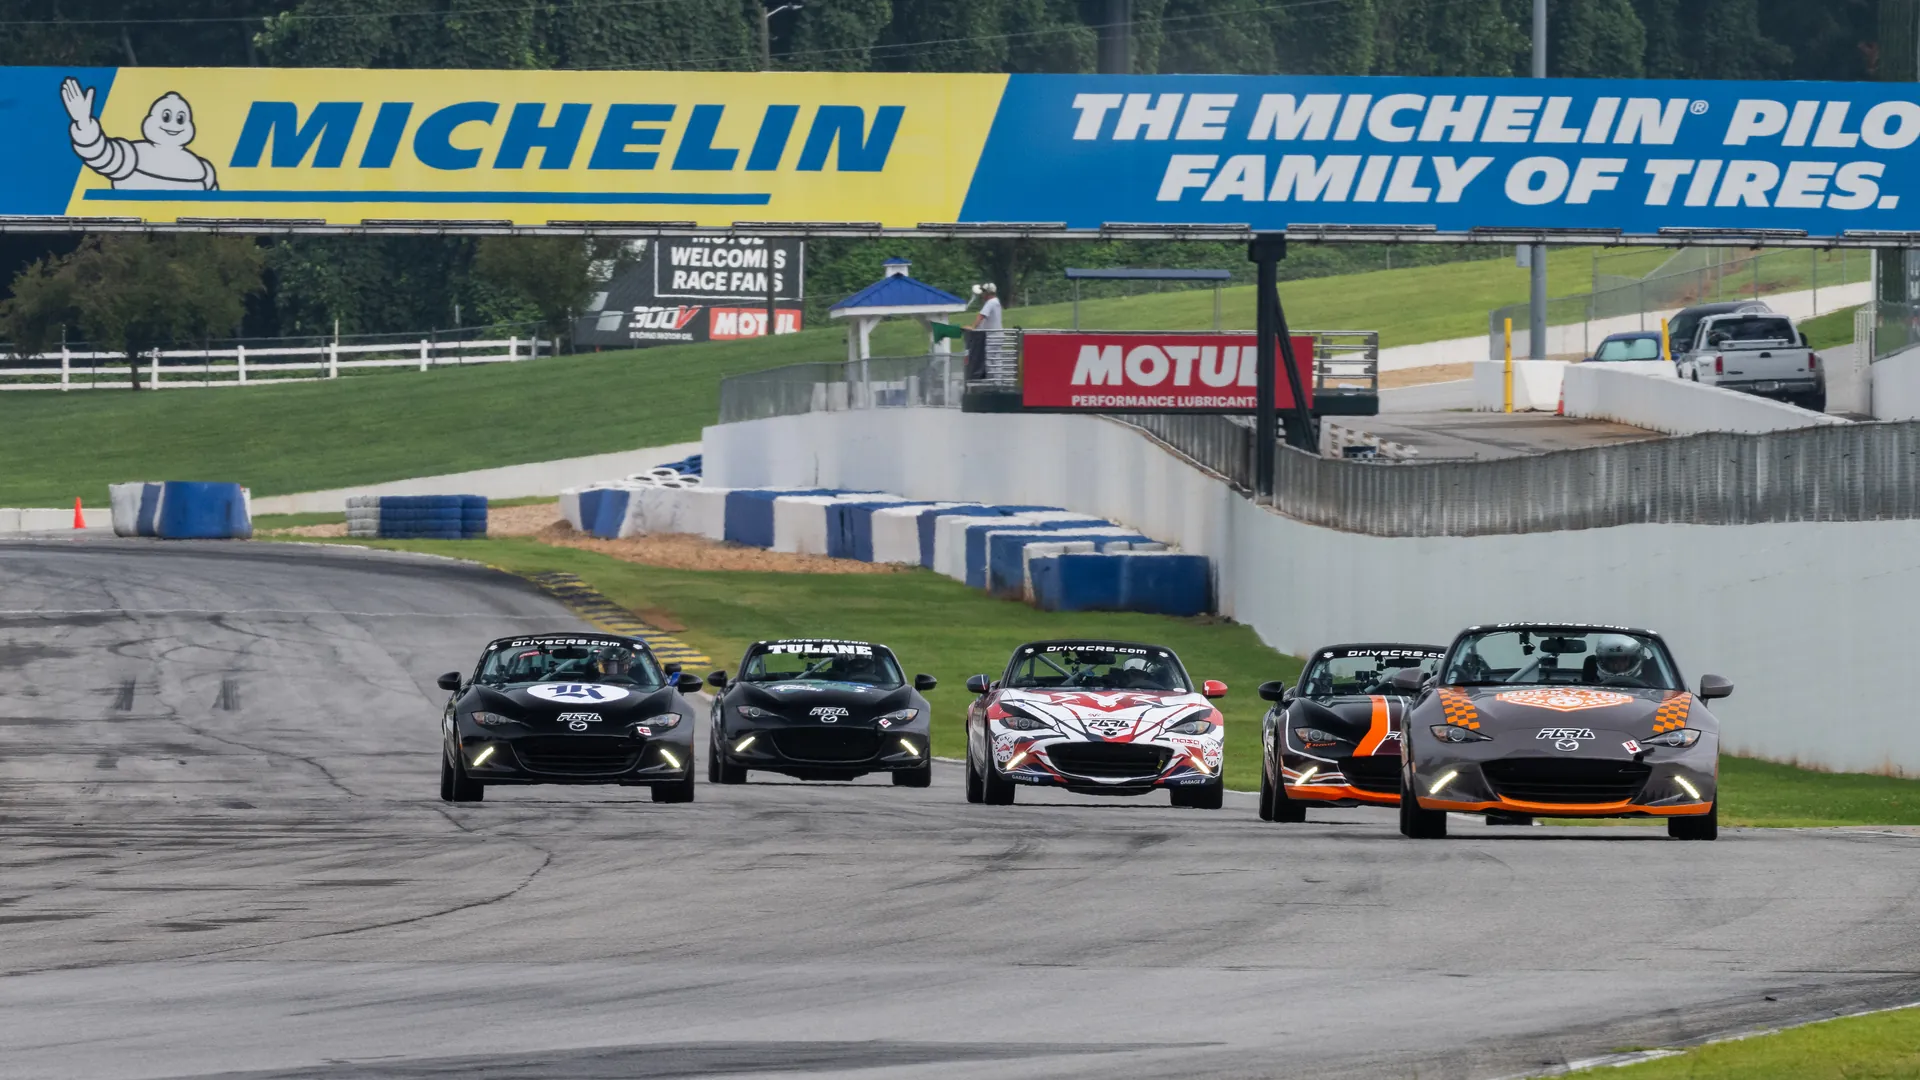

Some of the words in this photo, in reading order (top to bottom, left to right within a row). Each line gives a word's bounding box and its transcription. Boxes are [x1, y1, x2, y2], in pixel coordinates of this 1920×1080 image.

[1072, 93, 1238, 141] THE
[1722, 99, 1920, 149] PILO
[228, 101, 906, 172] MICHELIN
[1156, 154, 1495, 202] FAMILY
[1504, 156, 1628, 206] OF
[1644, 158, 1900, 210] TIRES.
[672, 270, 728, 291] RACE
[1071, 395, 1175, 407] PERFORMANCE
[1178, 396, 1258, 407] LUBRICANT
[768, 643, 873, 655] TULANE
[1347, 649, 1446, 659] DriveCRS.co
